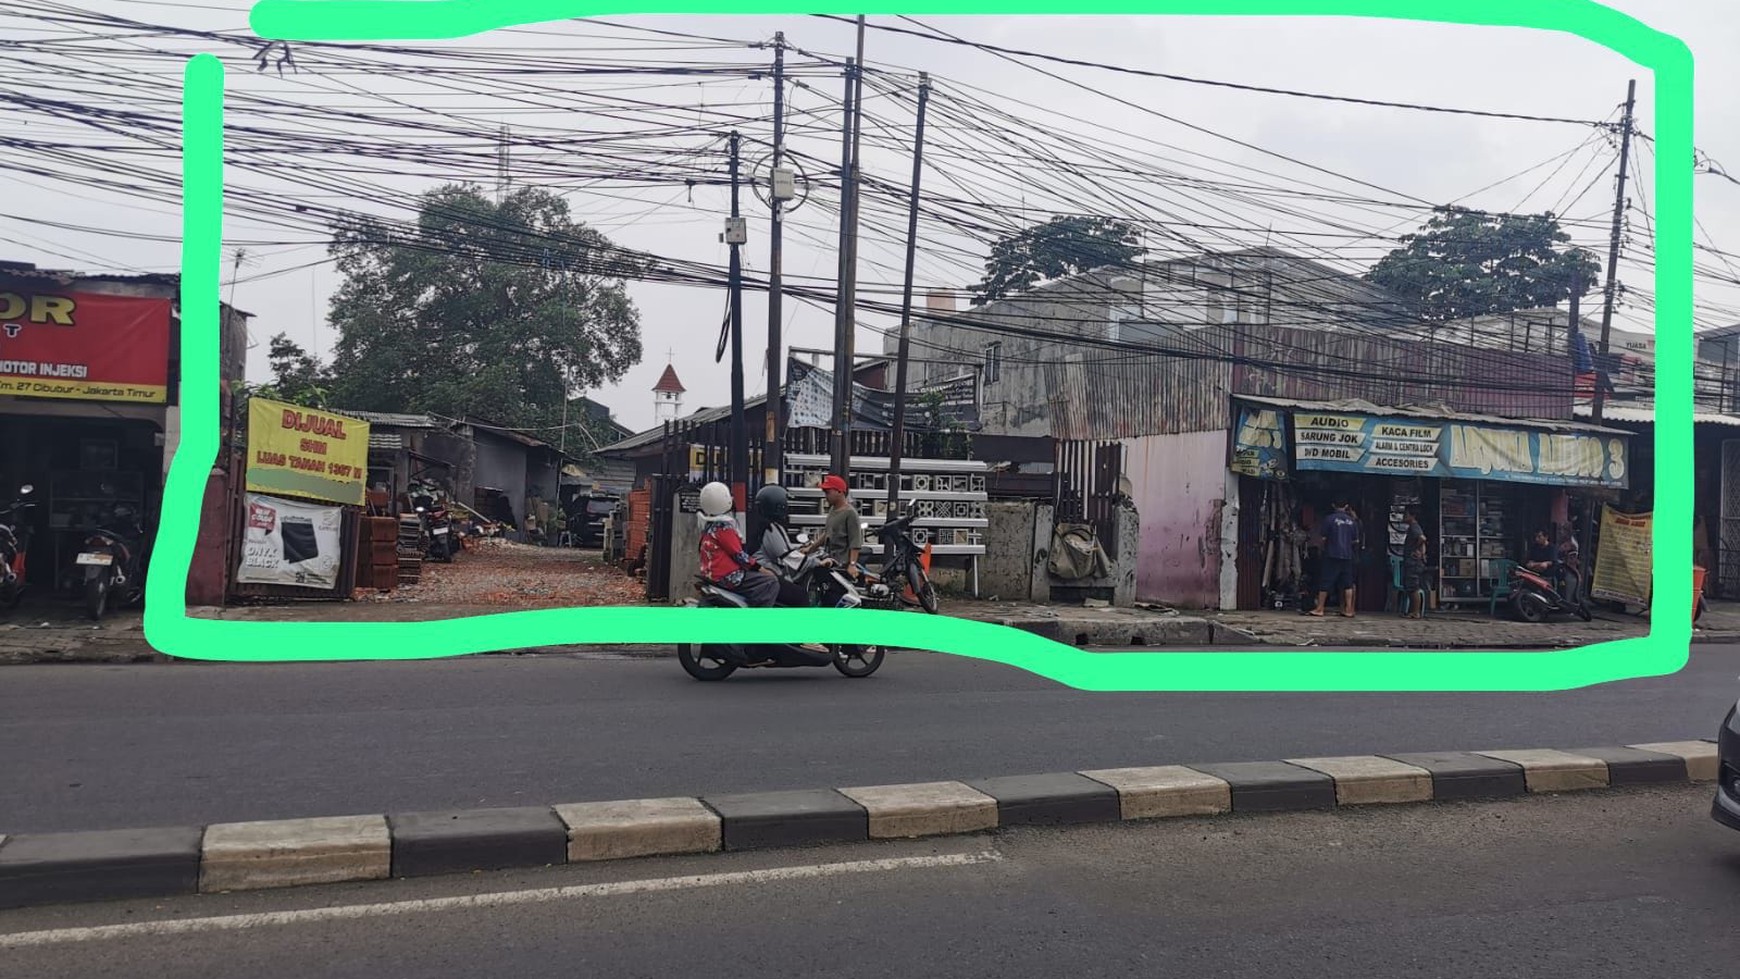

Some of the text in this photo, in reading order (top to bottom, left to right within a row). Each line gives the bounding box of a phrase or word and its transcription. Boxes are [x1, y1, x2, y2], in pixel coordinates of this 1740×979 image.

[39, 363, 88, 378] INJEKSI
[16, 382, 32, 391] 27
[33, 383, 74, 393] Cibubur
[82, 386, 124, 397] Jakarta
[127, 388, 156, 398] Timur
[281, 409, 347, 440] DIJUAL
[1310, 417, 1349, 428] AUDIO
[1300, 431, 1358, 444] SARUNG JOK
[1381, 426, 1432, 439] KACA FILM
[1321, 449, 1350, 459] MOBIL
[1420, 444, 1433, 453] LOCK
[257, 451, 286, 466] LUAS
[288, 455, 326, 472] TANAH
[1375, 456, 1429, 469] ACCESORIES
[1608, 438, 1625, 479] 3
[246, 557, 280, 570] BLACK
